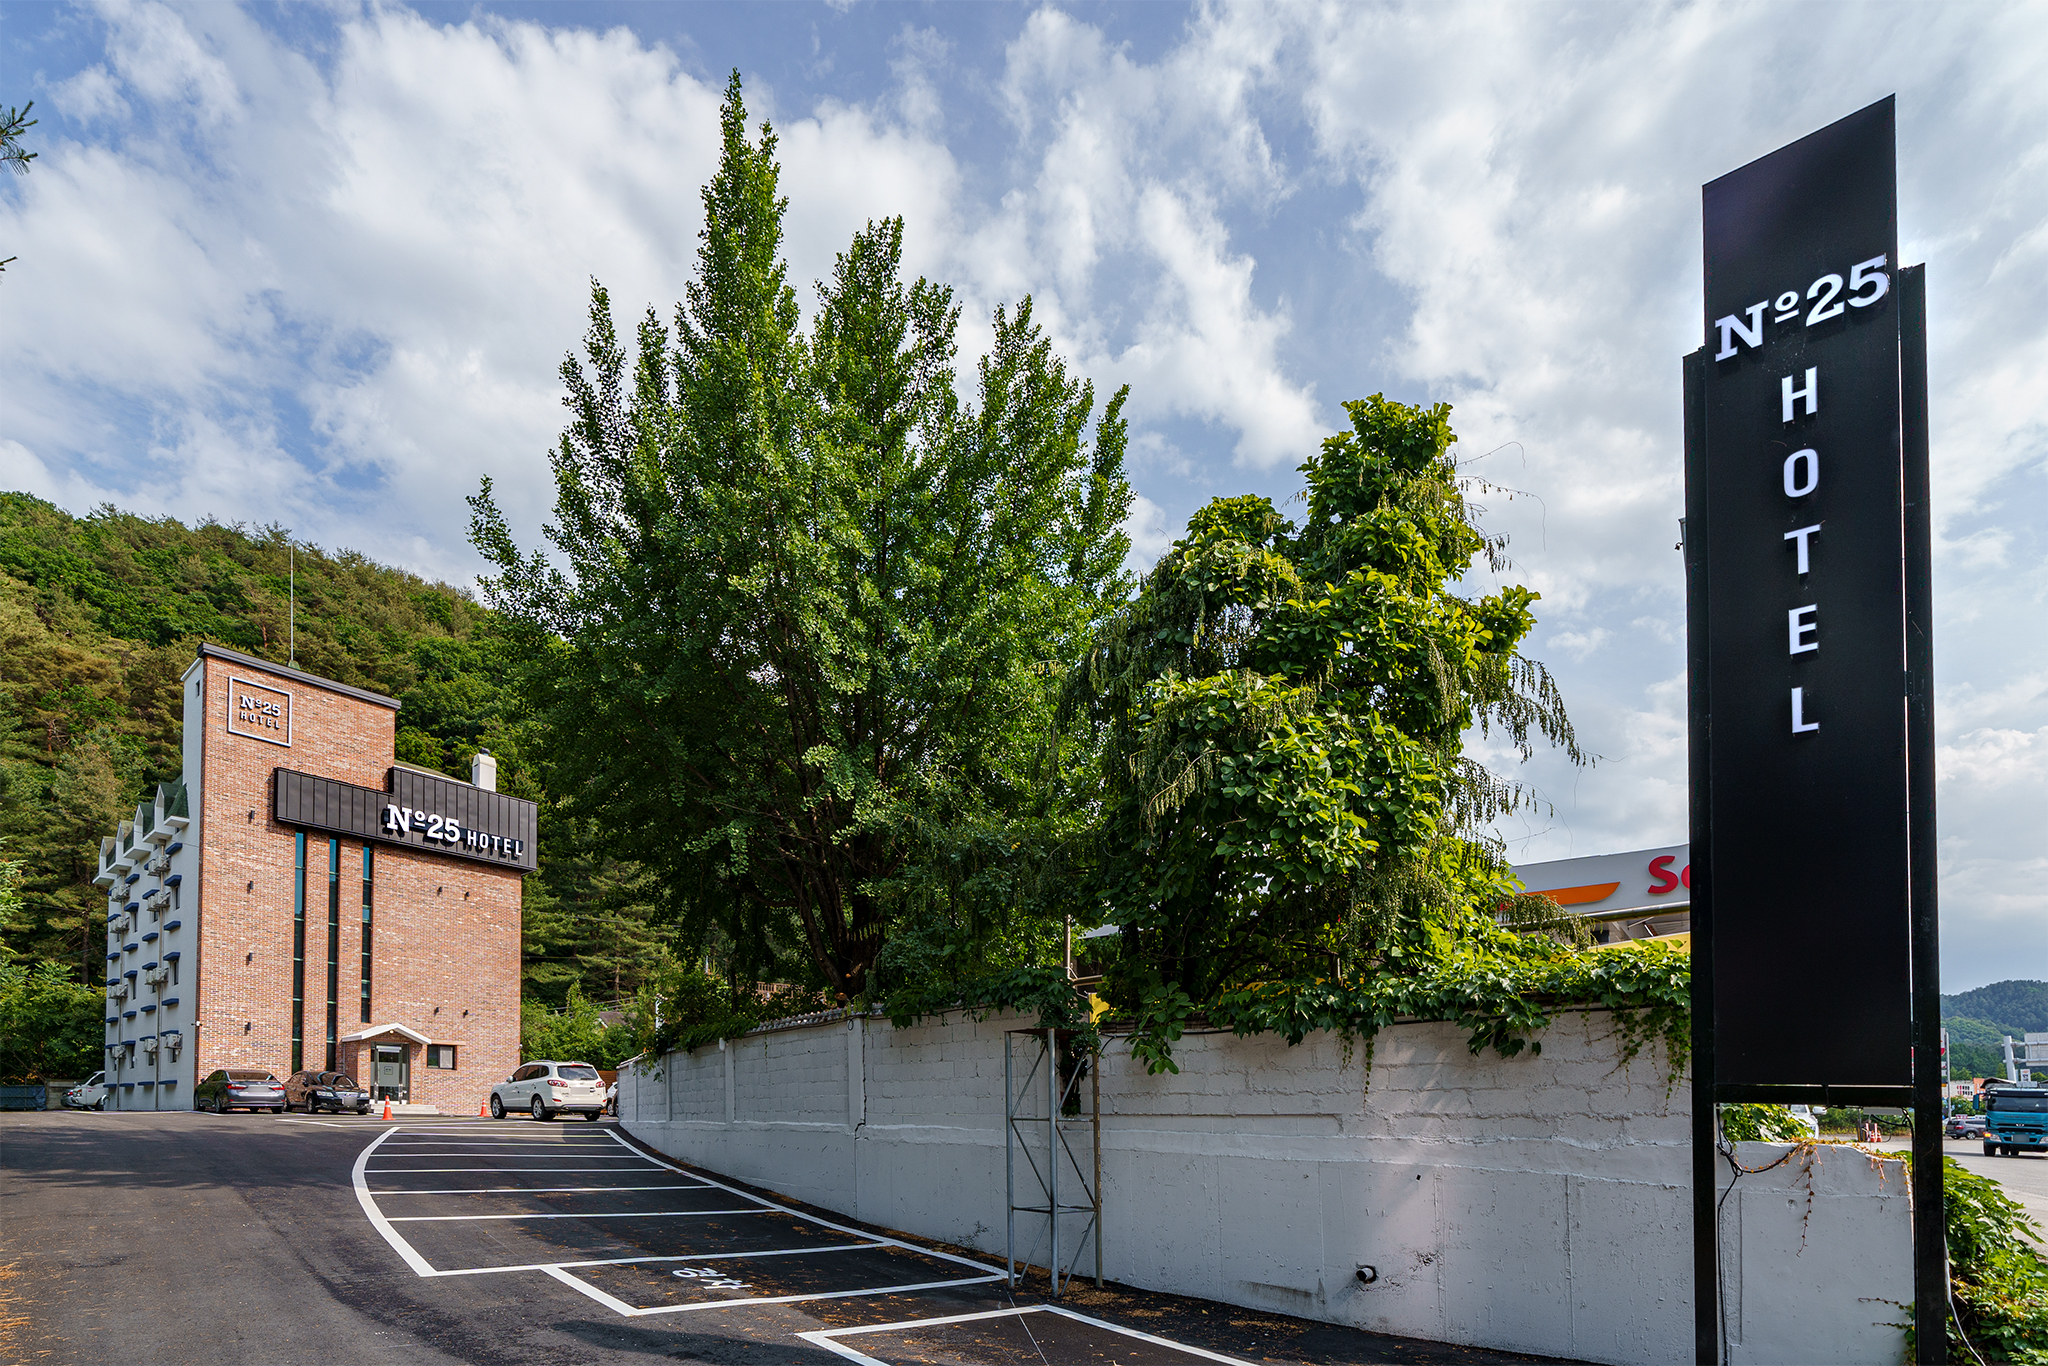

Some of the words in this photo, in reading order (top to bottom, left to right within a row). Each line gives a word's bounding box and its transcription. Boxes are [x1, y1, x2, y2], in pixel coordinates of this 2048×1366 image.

[1781, 366, 1821, 734] HOTEL
[240, 711, 280, 730] HOTEL
[467, 830, 522, 856] HOTEL
